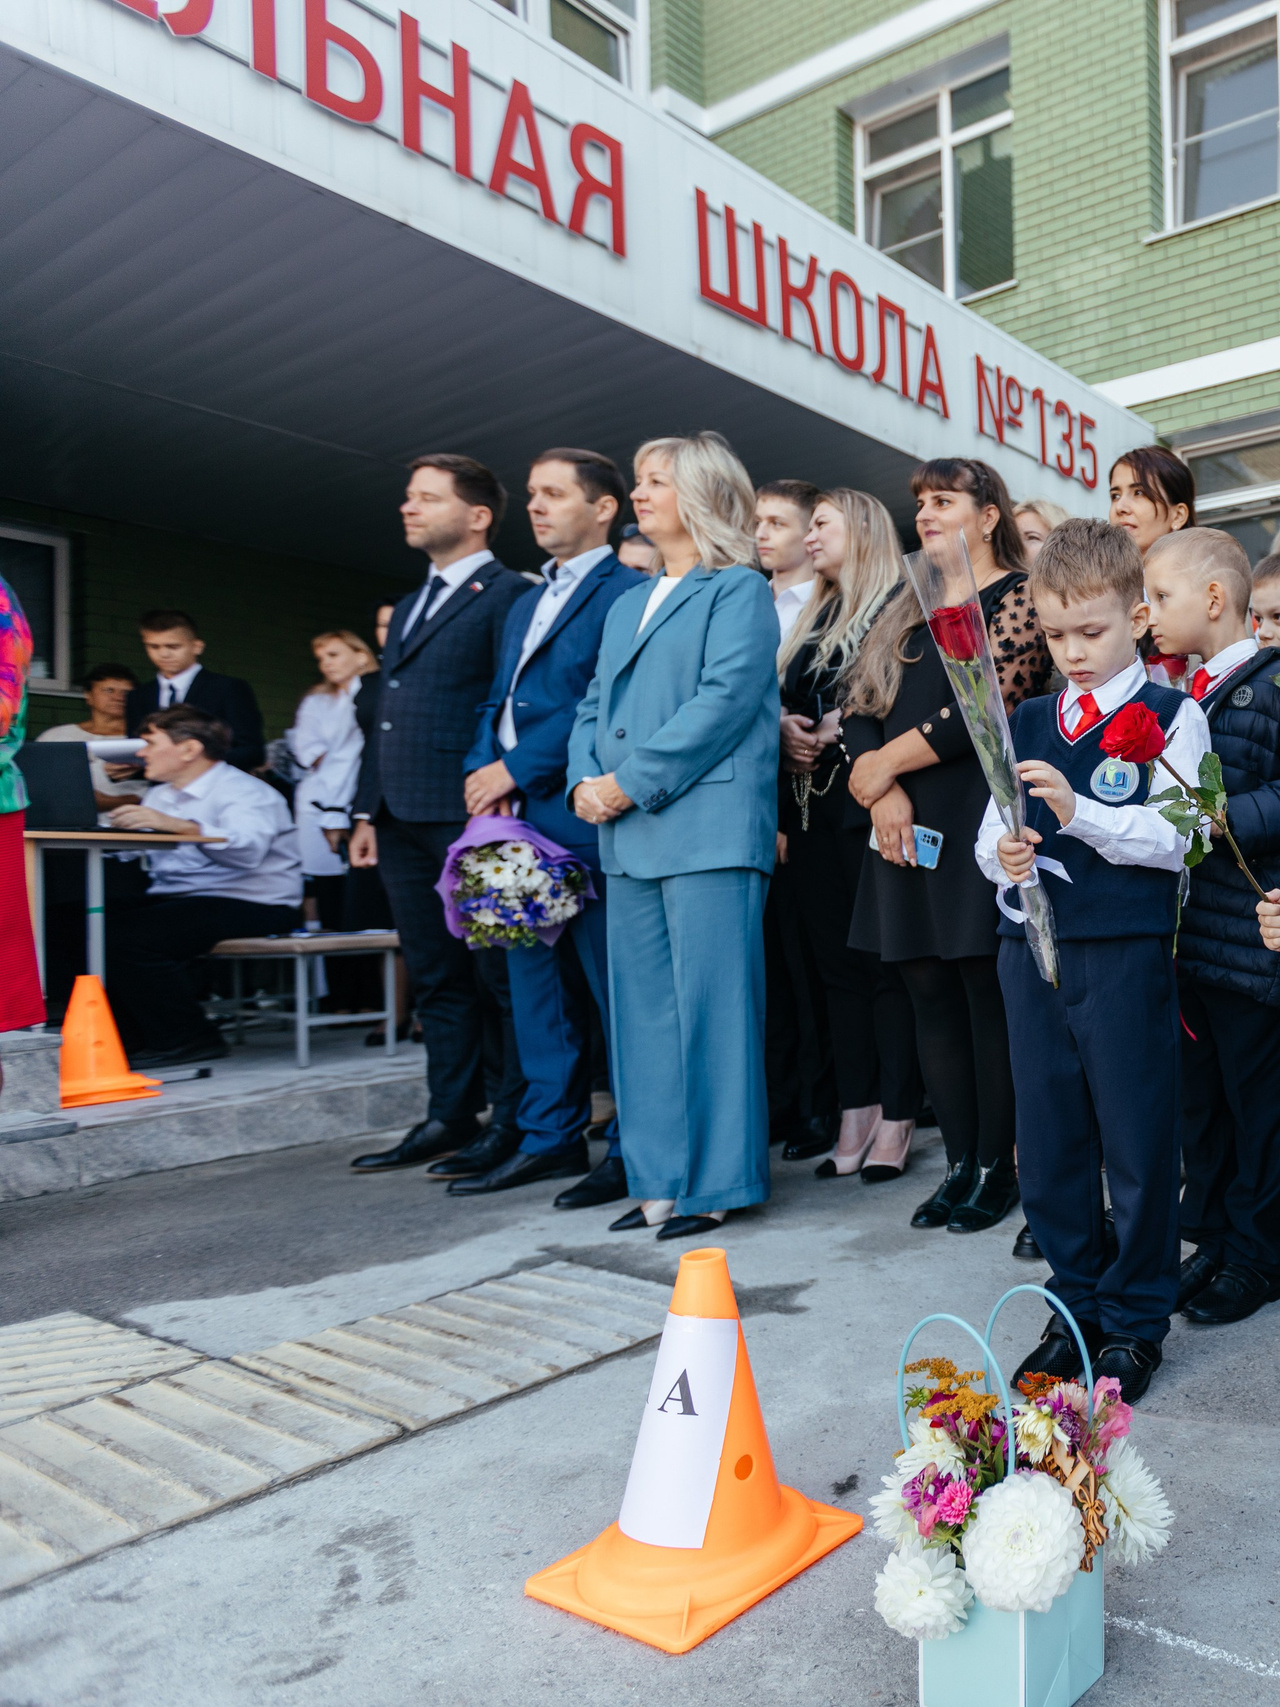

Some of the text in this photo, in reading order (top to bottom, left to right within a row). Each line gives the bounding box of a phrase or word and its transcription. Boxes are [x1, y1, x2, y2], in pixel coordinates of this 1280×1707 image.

[119, 0, 1098, 490] ЬНАЯ ШКОЛА №135
[657, 1368, 699, 1416] А
